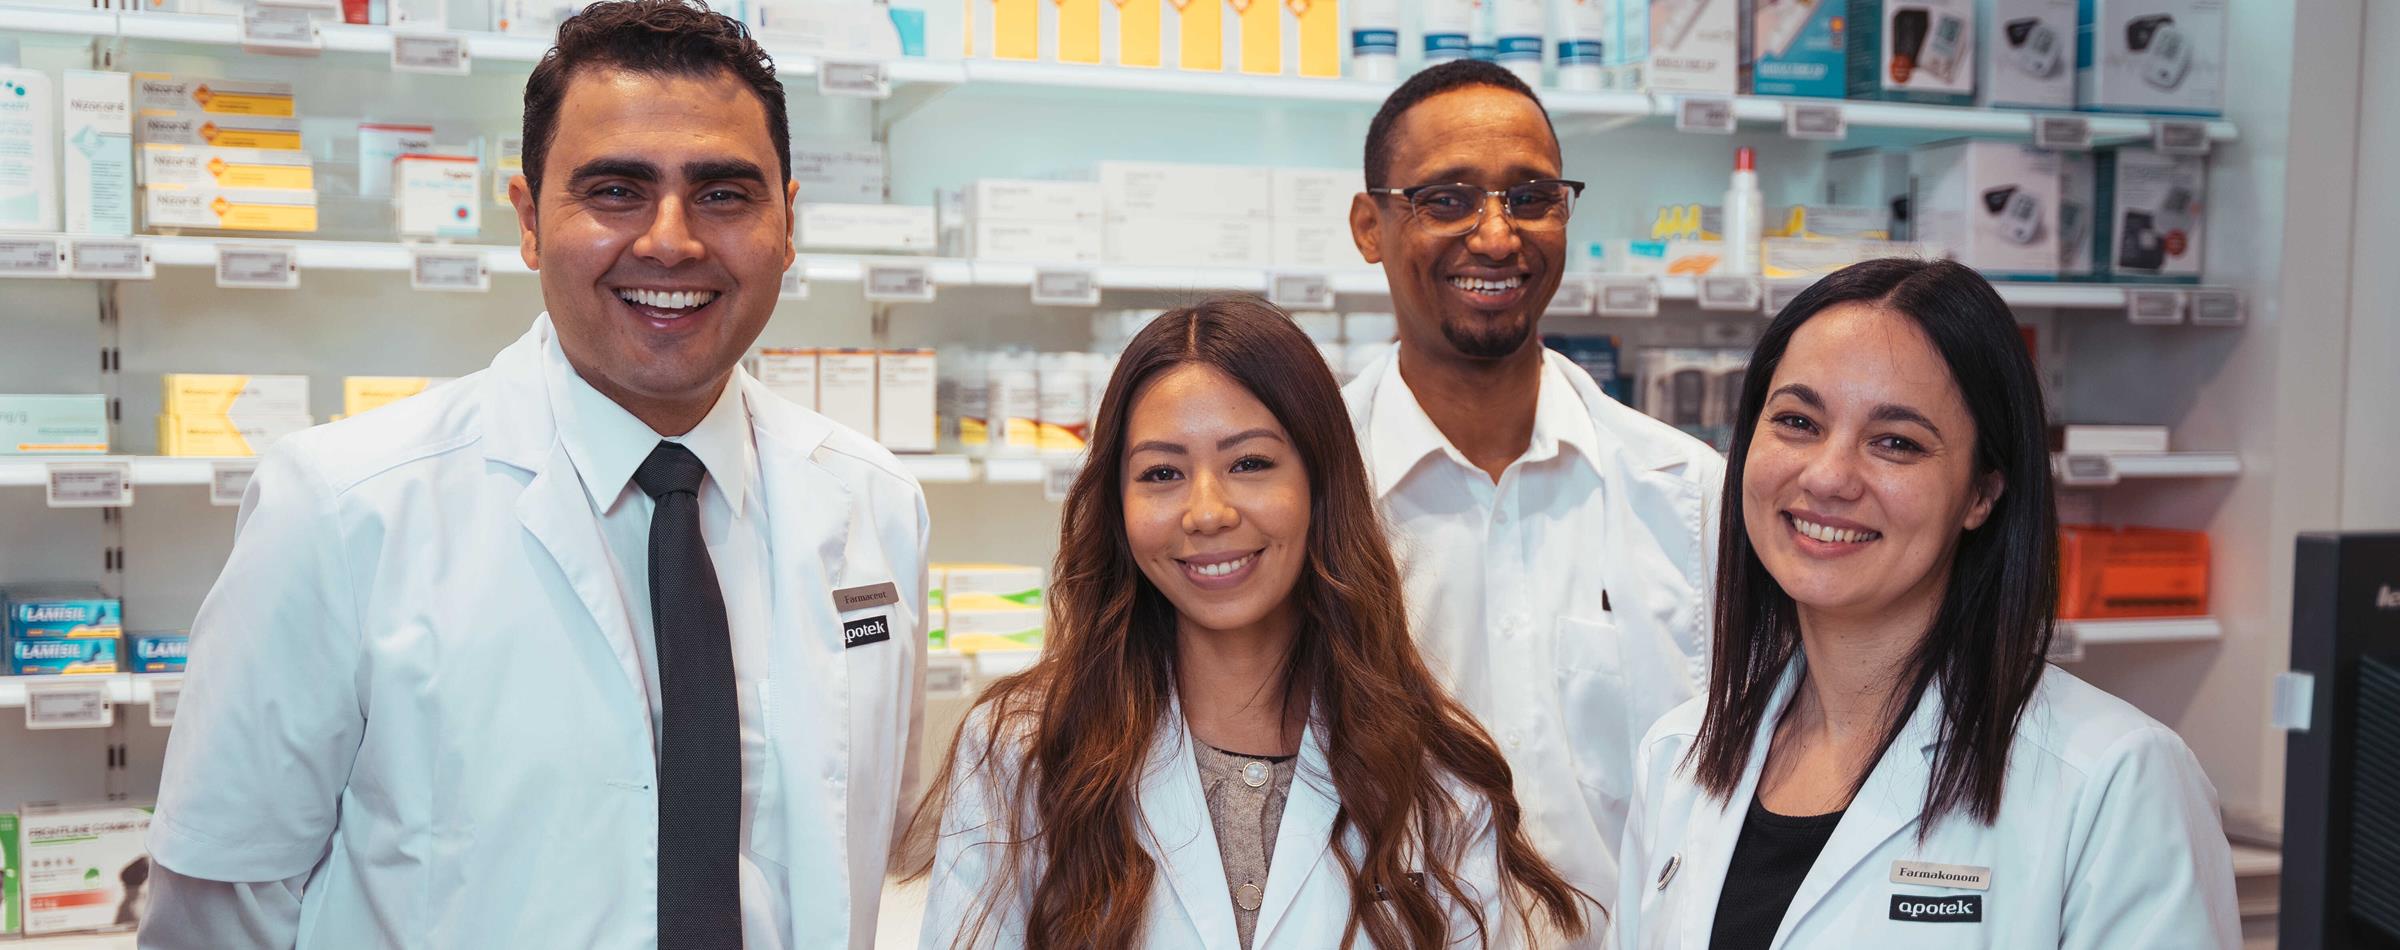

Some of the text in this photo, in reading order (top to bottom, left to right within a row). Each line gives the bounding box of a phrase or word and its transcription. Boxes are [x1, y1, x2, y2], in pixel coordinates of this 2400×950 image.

[844, 591, 887, 604] Farmaceut
[27, 606, 86, 622] LAMISIL
[844, 620, 886, 643] potek
[22, 643, 81, 659] LAMISIL
[146, 643, 187, 659] LAMI
[1899, 867, 1980, 883] Farmakonom
[1898, 900, 1974, 918] apotek
